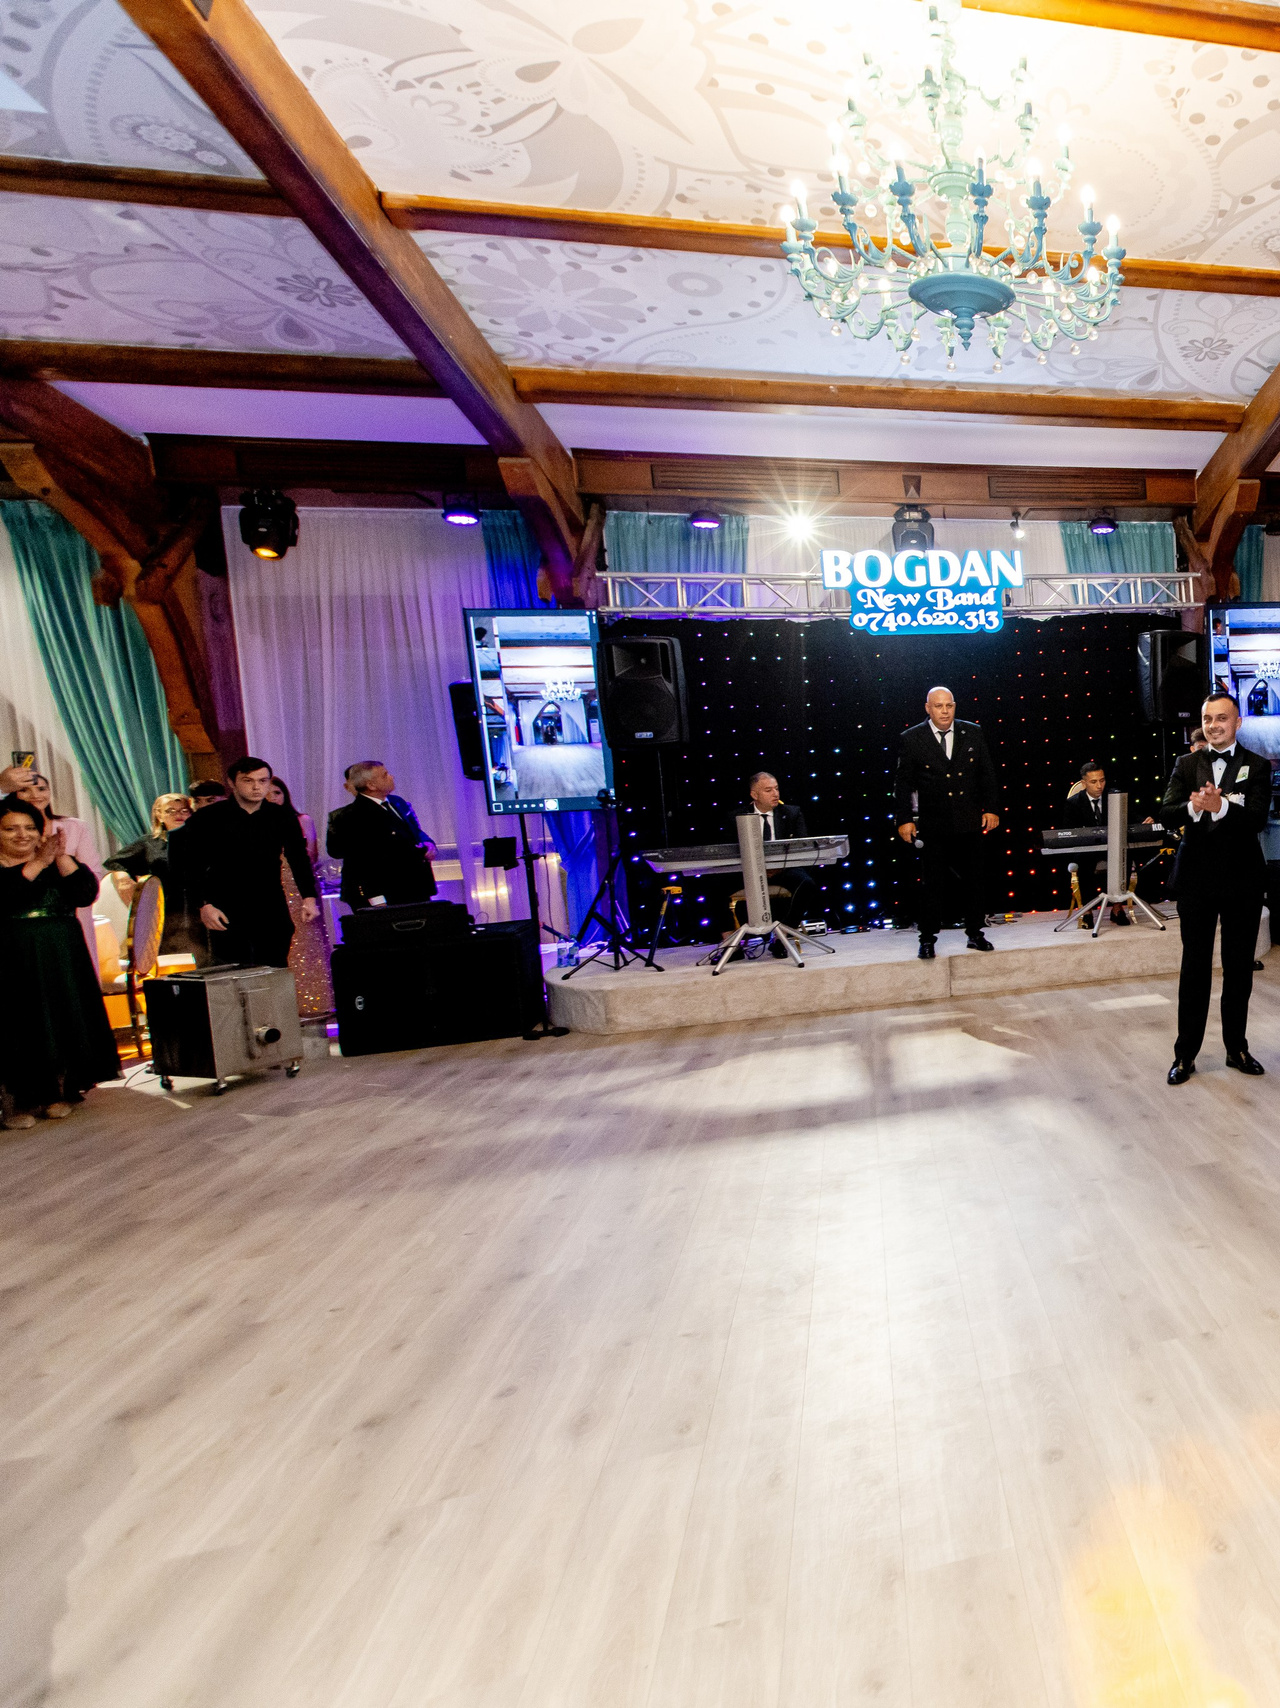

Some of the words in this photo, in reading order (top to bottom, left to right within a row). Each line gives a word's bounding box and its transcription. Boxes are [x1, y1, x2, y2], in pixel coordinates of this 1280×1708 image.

[822, 549, 1023, 588] BOGDAN
[857, 588, 920, 611] New
[926, 588, 996, 610] Band
[853, 608, 999, 631] 0740.620.313
